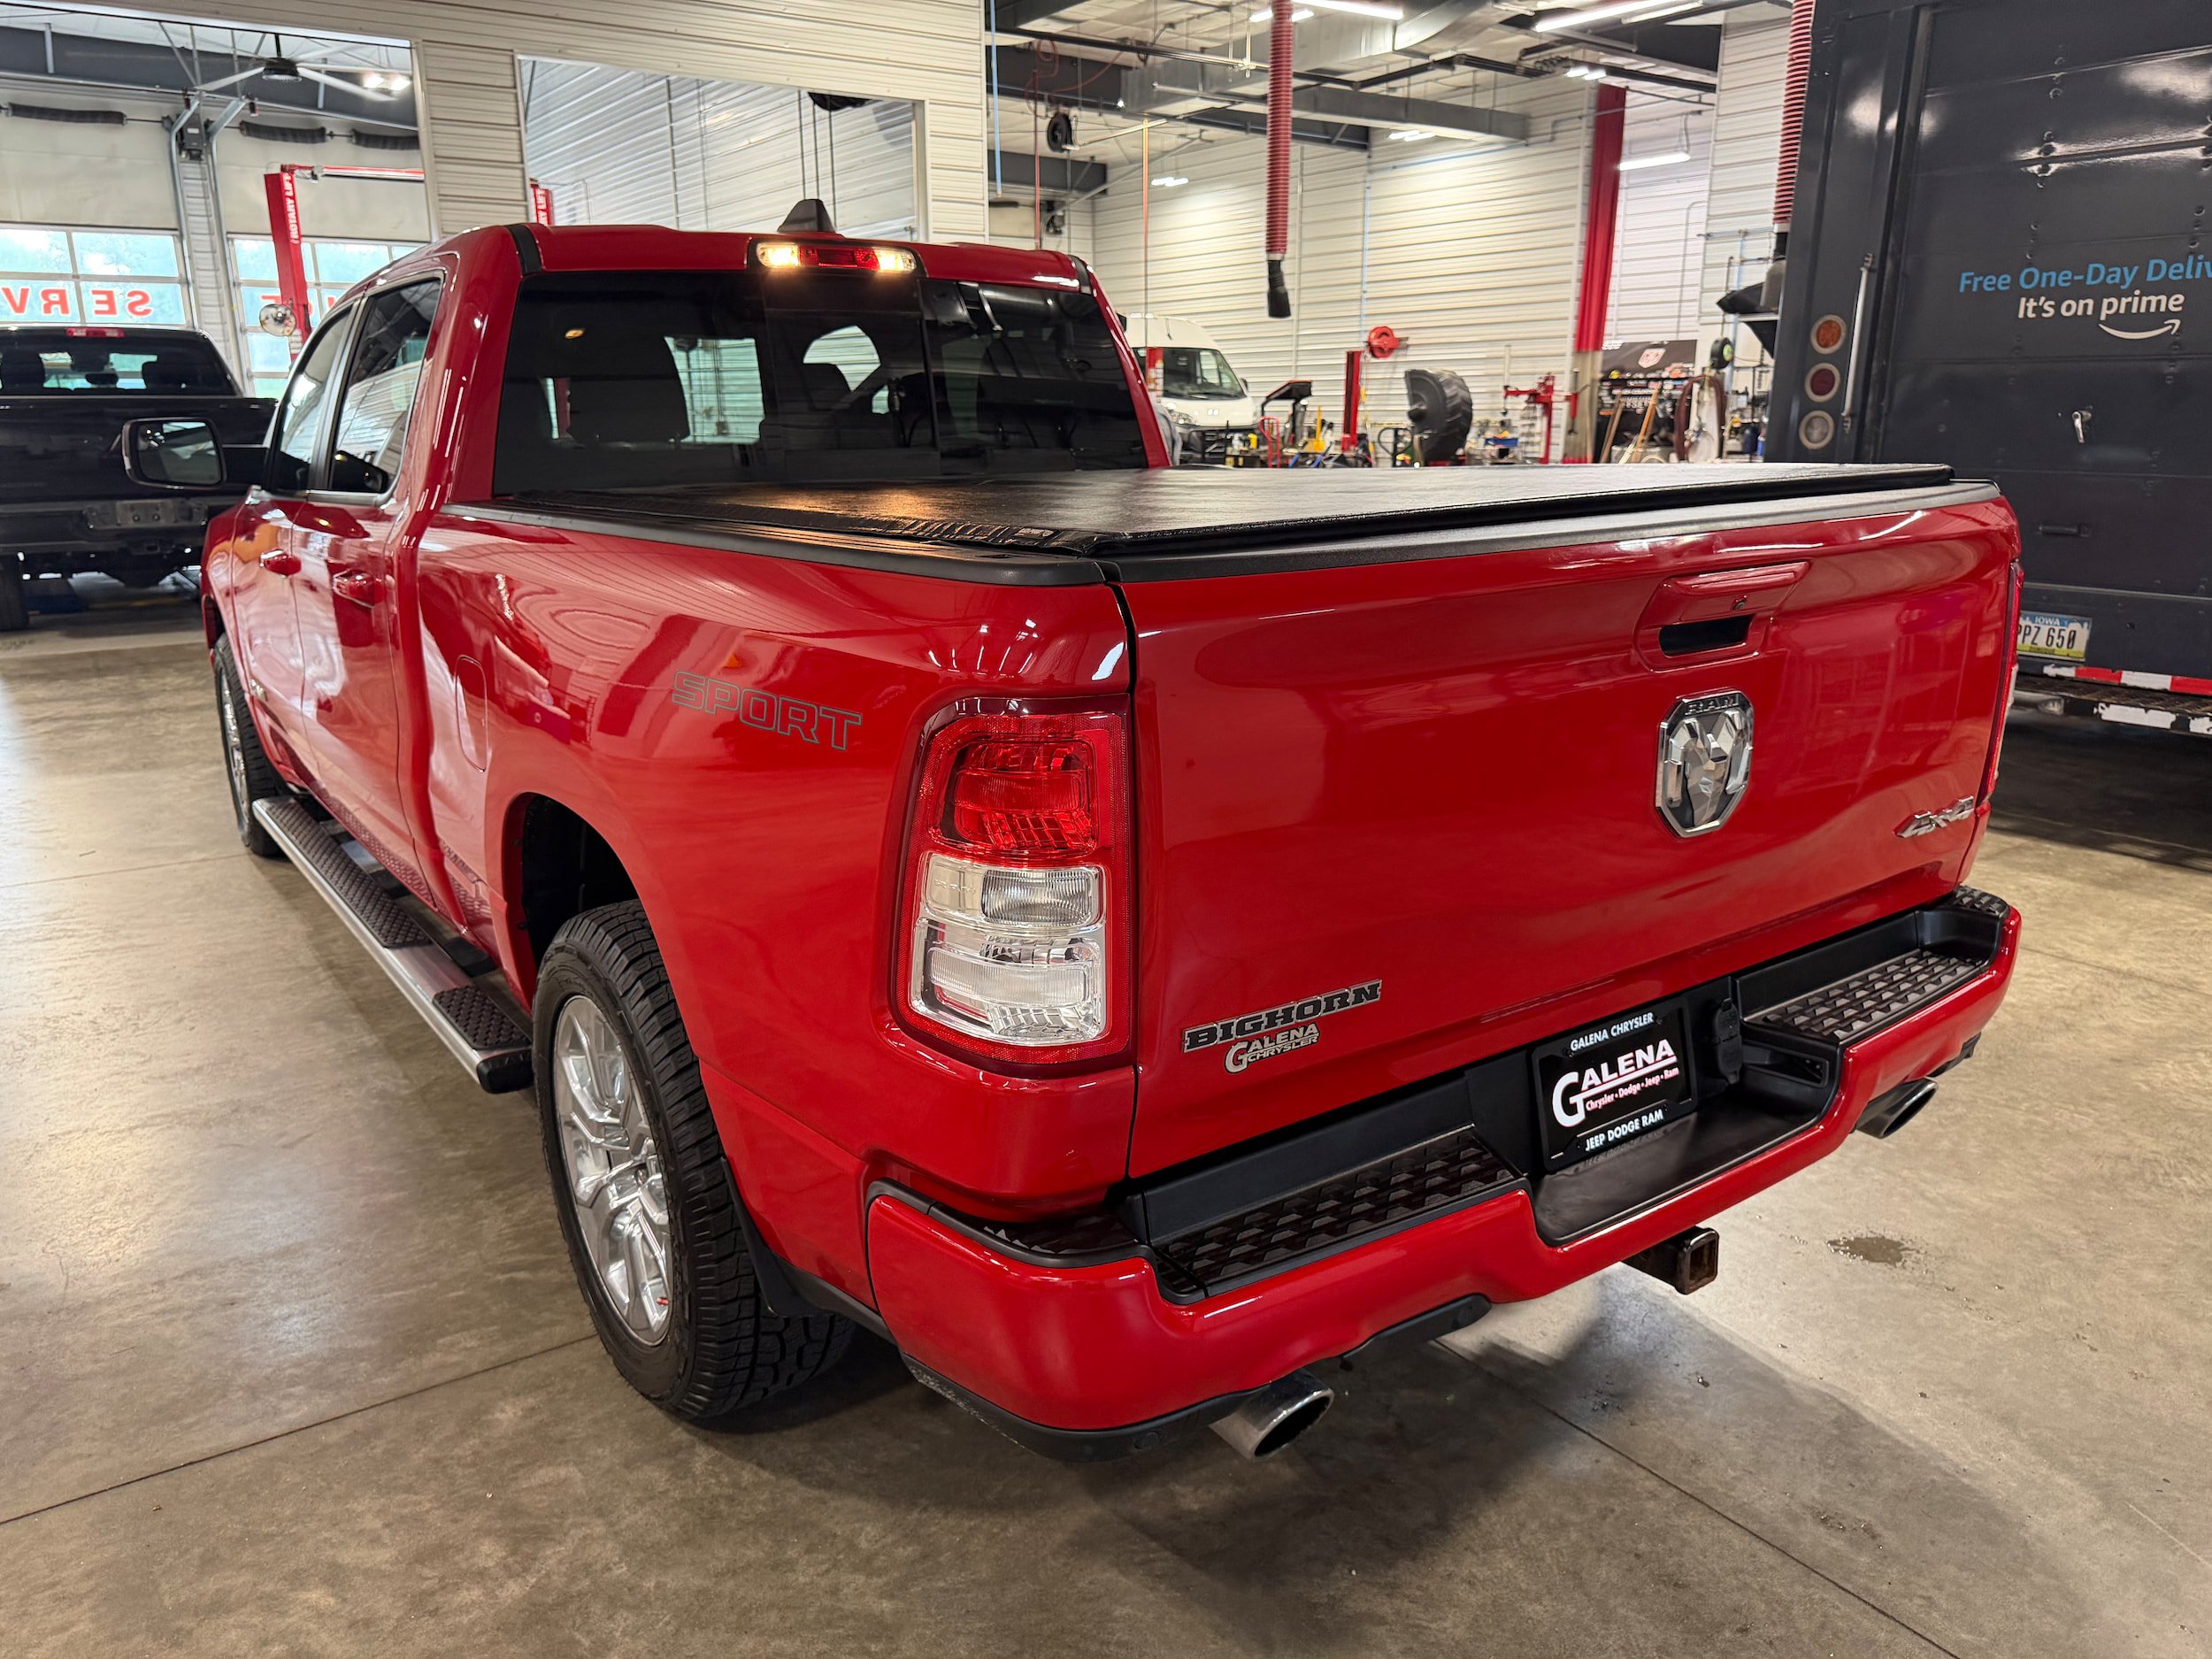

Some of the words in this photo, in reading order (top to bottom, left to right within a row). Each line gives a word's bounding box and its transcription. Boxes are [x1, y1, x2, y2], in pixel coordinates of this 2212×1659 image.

[282, 173, 295, 196] LIFT
[536, 188, 548, 210] LIFT
[286, 196, 300, 240] ROTARY
[1959, 271, 2011, 293] Free
[2018, 263, 2139, 289] One-Day
[2017, 296, 2055, 319] It's
[2060, 298, 2093, 317] on
[2099, 288, 2185, 321] prime
[2034, 615, 2061, 626] IOWA
[2045, 626, 2077, 649] 650
[672, 671, 863, 750] SPORT
[1183, 979, 1383, 1053] BIGHORN
[1570, 1030, 1609, 1051] GALENA
[1610, 1011, 1654, 1036] CHRYSLER
[1225, 1023, 1320, 1073] GALENA
[1246, 1034, 1319, 1064] CHRYSLER
[1552, 1039, 1678, 1128] GALENA
[1586, 1092, 1615, 1111] Chrysler
[1617, 1082, 1642, 1099] Dodge
[1643, 1074, 1661, 1088] Jeep
[1663, 1067, 1679, 1080] Ram
[1586, 1133, 1605, 1151] JEEP
[1608, 1118, 1640, 1141] DODGE
[1642, 1109, 1663, 1126] RAM
